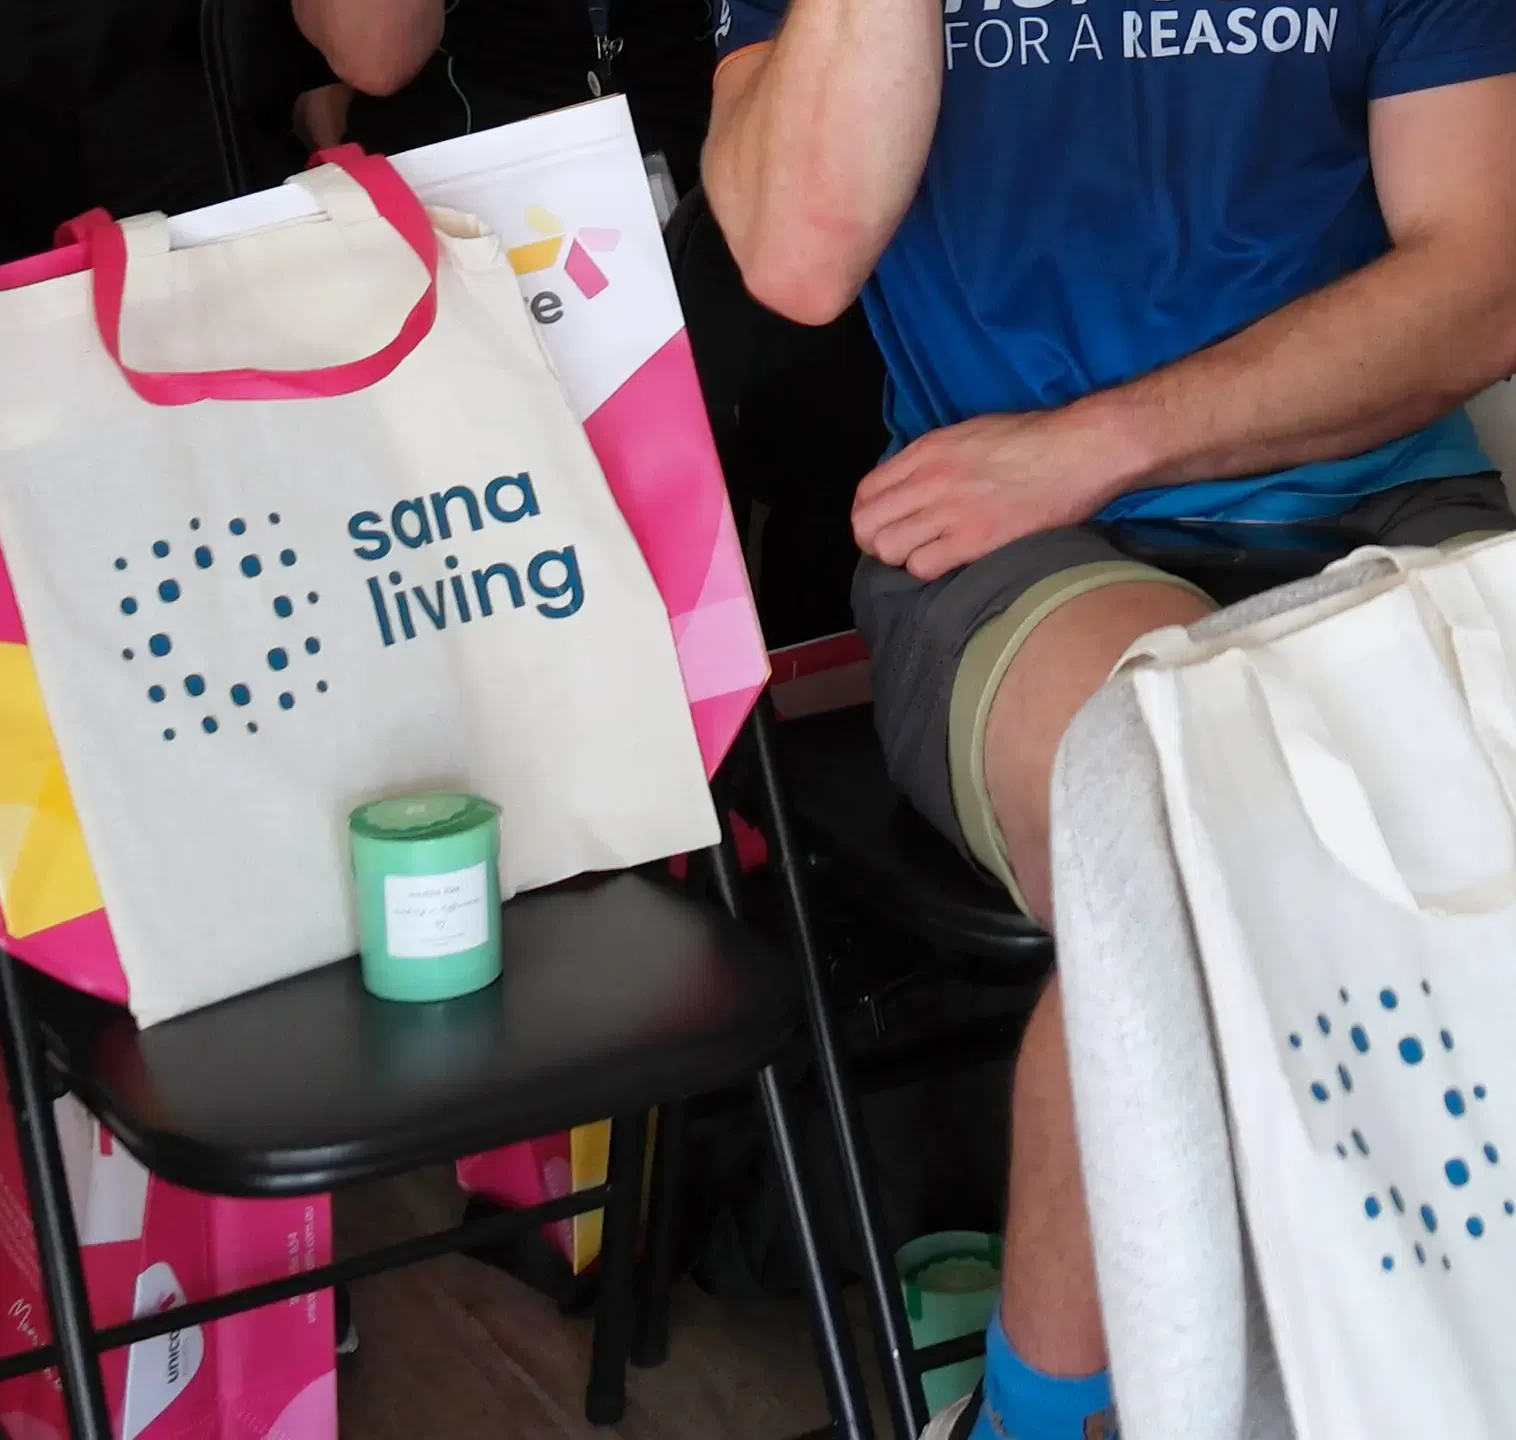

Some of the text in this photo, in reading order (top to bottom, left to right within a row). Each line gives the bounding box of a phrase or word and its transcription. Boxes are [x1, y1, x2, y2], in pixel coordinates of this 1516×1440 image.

[945, 7, 1338, 71] FOR A REASON
[347, 471, 541, 560] sana
[367, 545, 585, 648] living
